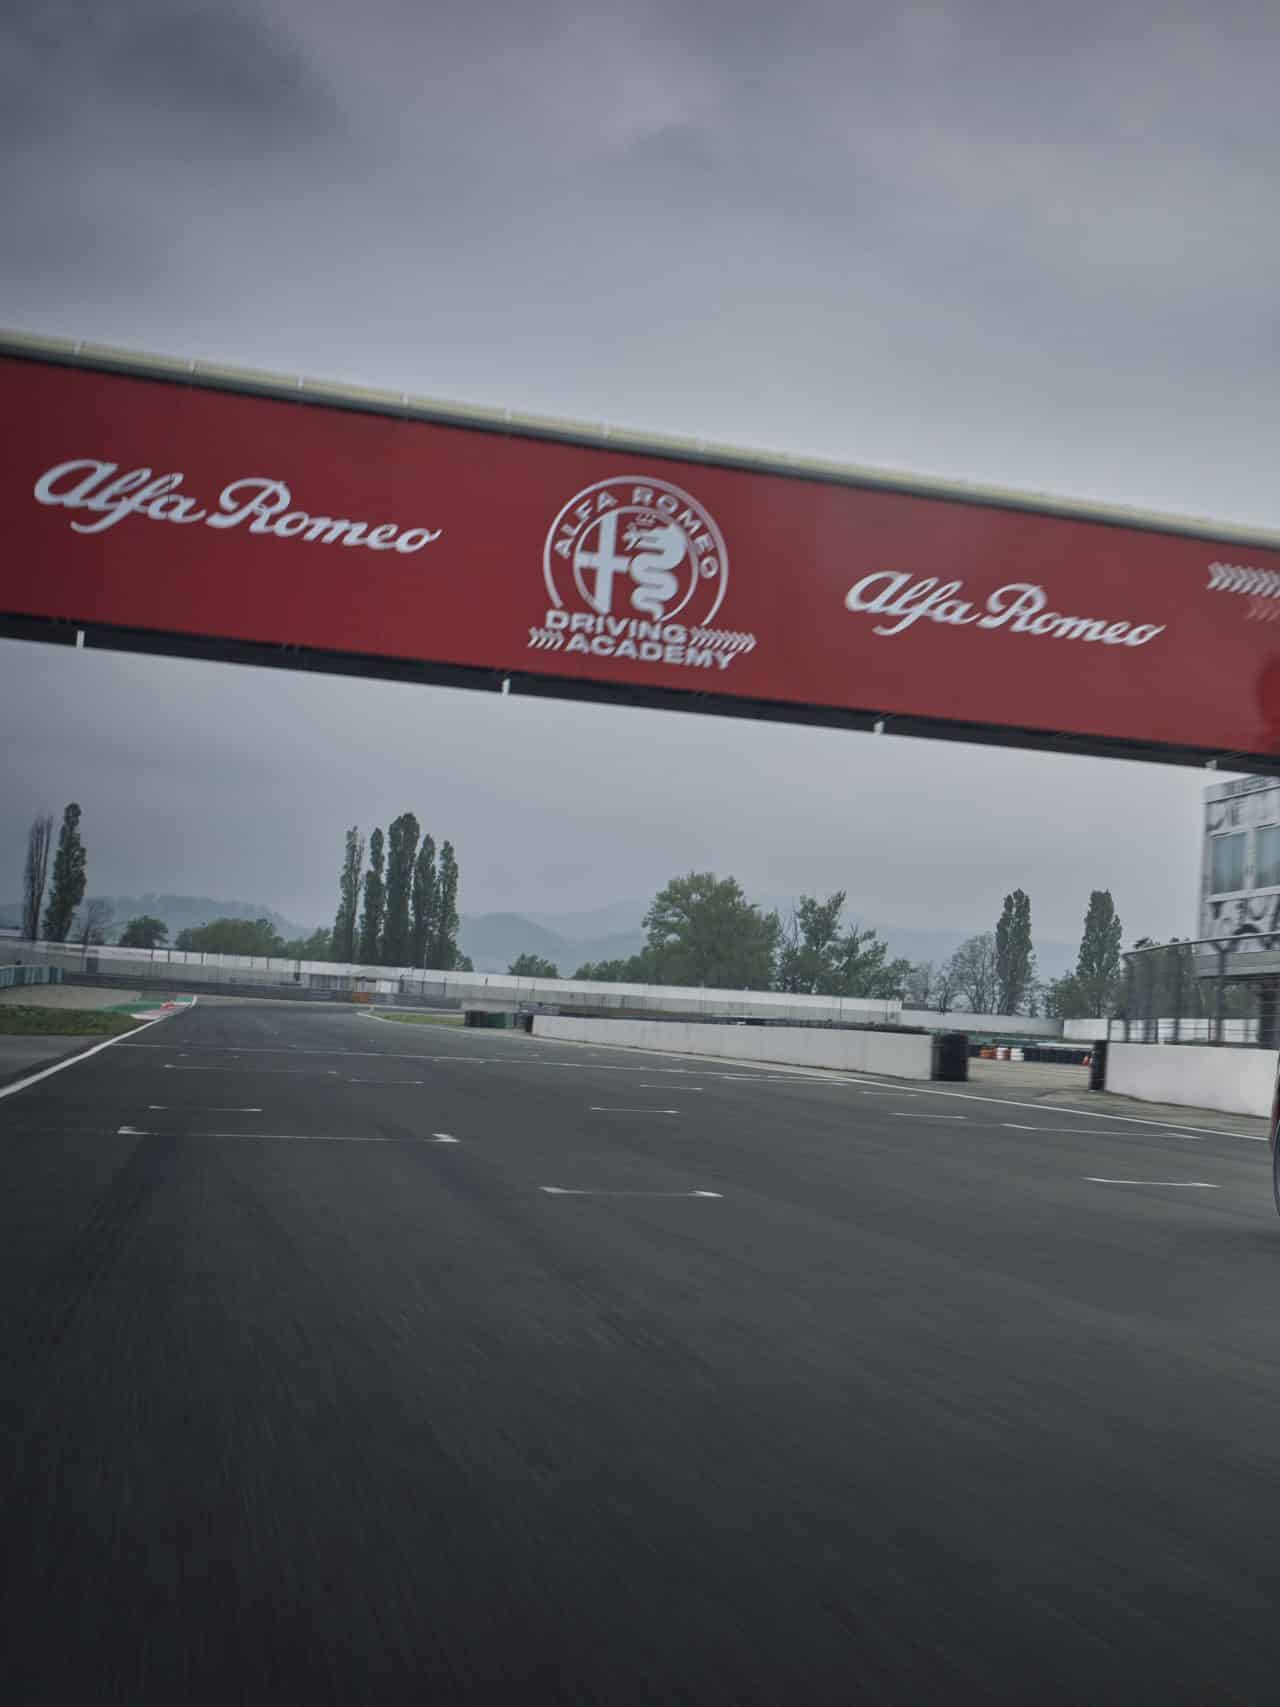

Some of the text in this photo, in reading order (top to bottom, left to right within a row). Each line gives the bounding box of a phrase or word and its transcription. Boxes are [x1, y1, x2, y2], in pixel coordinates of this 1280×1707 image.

[35, 459, 442, 553] Alfa Romeo
[554, 487, 719, 579] ALFA ROMEO
[545, 609, 688, 645] DRIVING
[845, 570, 1167, 646] Alfa Romeo
[566, 632, 737, 669] ACADEMY
